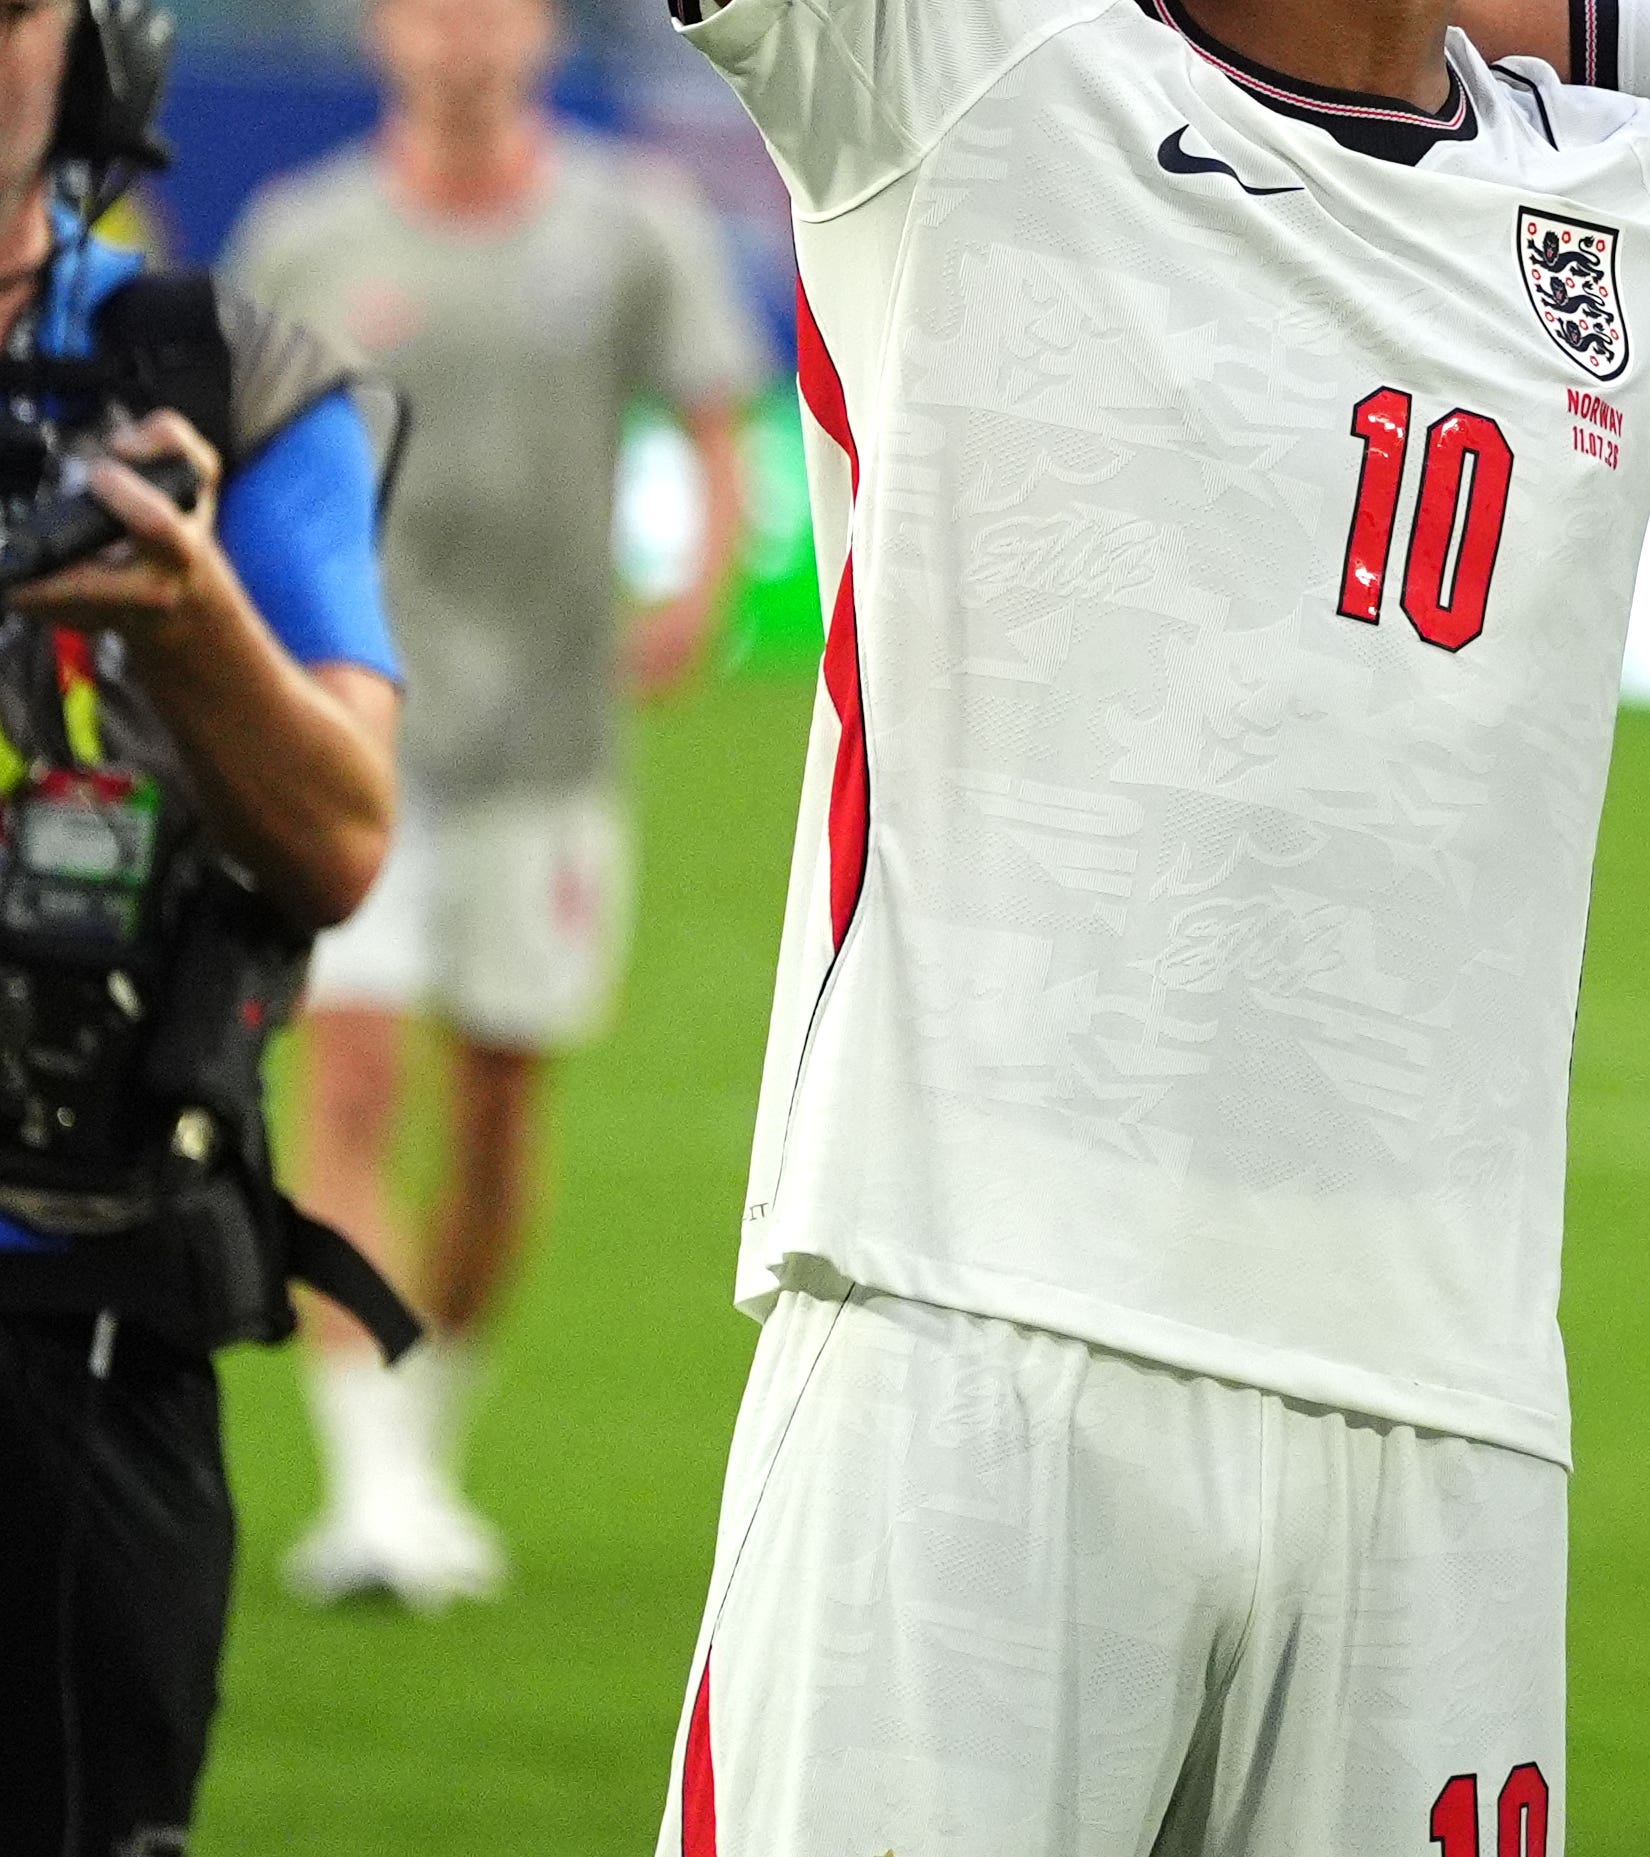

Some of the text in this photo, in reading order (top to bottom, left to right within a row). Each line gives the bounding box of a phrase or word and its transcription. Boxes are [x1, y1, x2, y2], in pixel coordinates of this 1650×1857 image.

[1567, 388, 1623, 438] NORWAY
[1573, 425, 1619, 472] 11.07.26
[1336, 385, 1514, 653] 10
